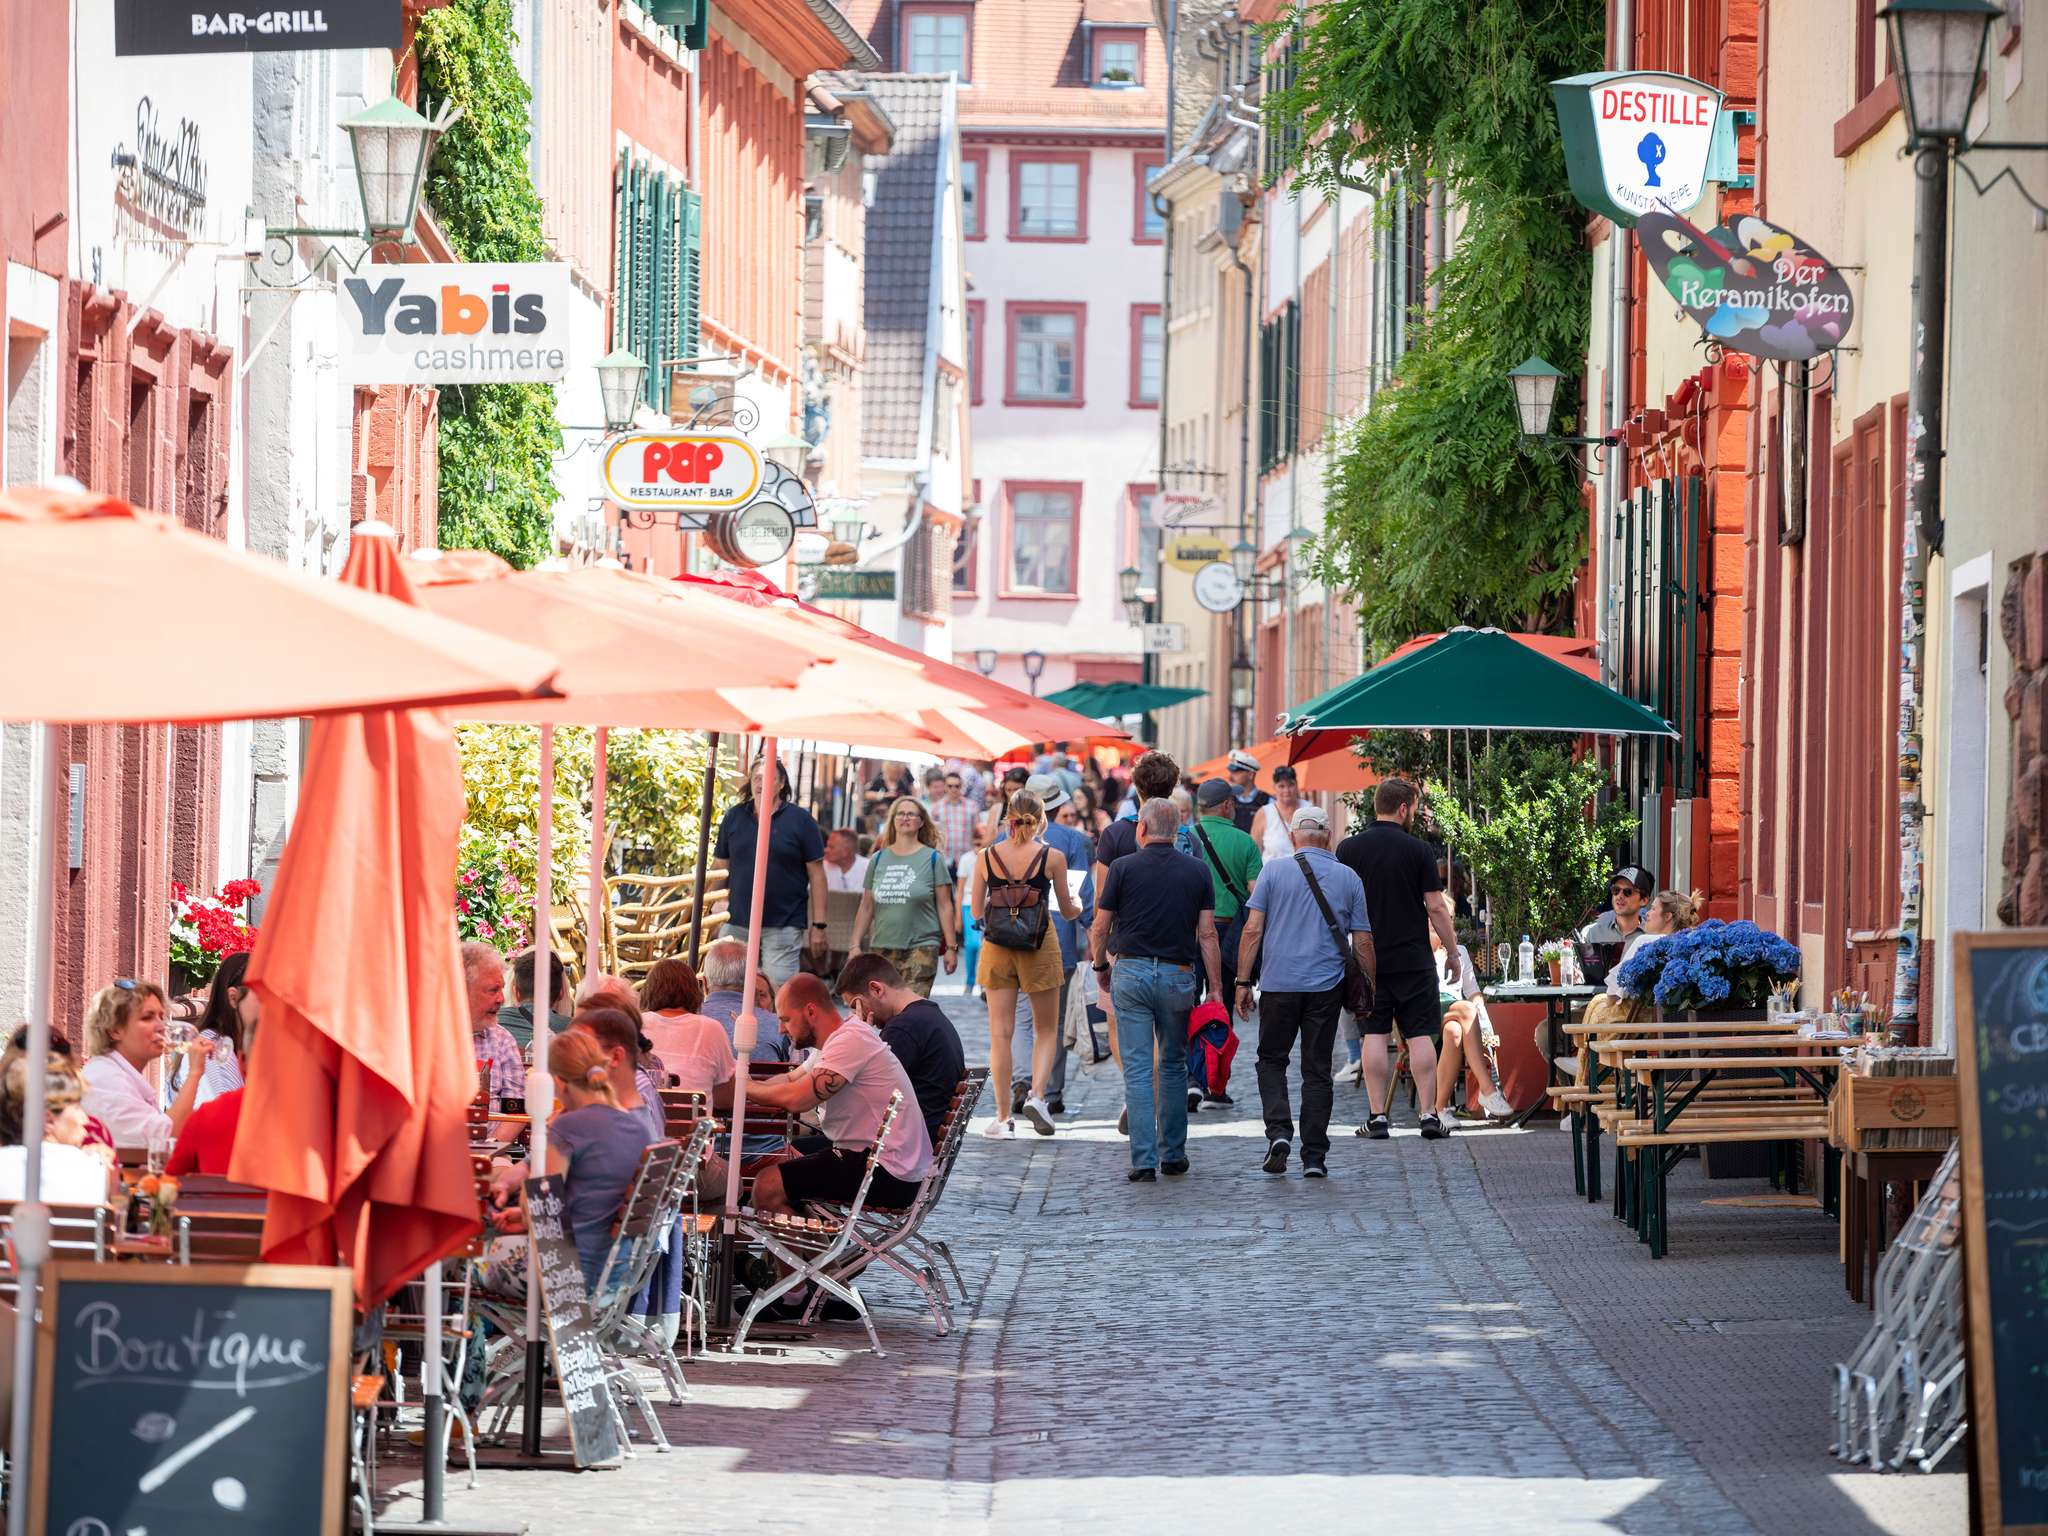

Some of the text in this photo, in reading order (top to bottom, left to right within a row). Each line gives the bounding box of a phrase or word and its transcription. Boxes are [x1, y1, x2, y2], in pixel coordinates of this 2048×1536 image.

[191, 10, 328, 36] BAR-GRILL
[1602, 89, 1709, 126] DESTILLE
[1616, 183, 1648, 209] KUNST
[1772, 257, 1825, 287] Der
[343, 278, 547, 336] Yabis
[1680, 281, 1849, 318] Keramikofen
[414, 343, 565, 371] cashmere
[629, 487, 733, 498] RESTAURANT BAR
[74, 1300, 324, 1398] Boutique
